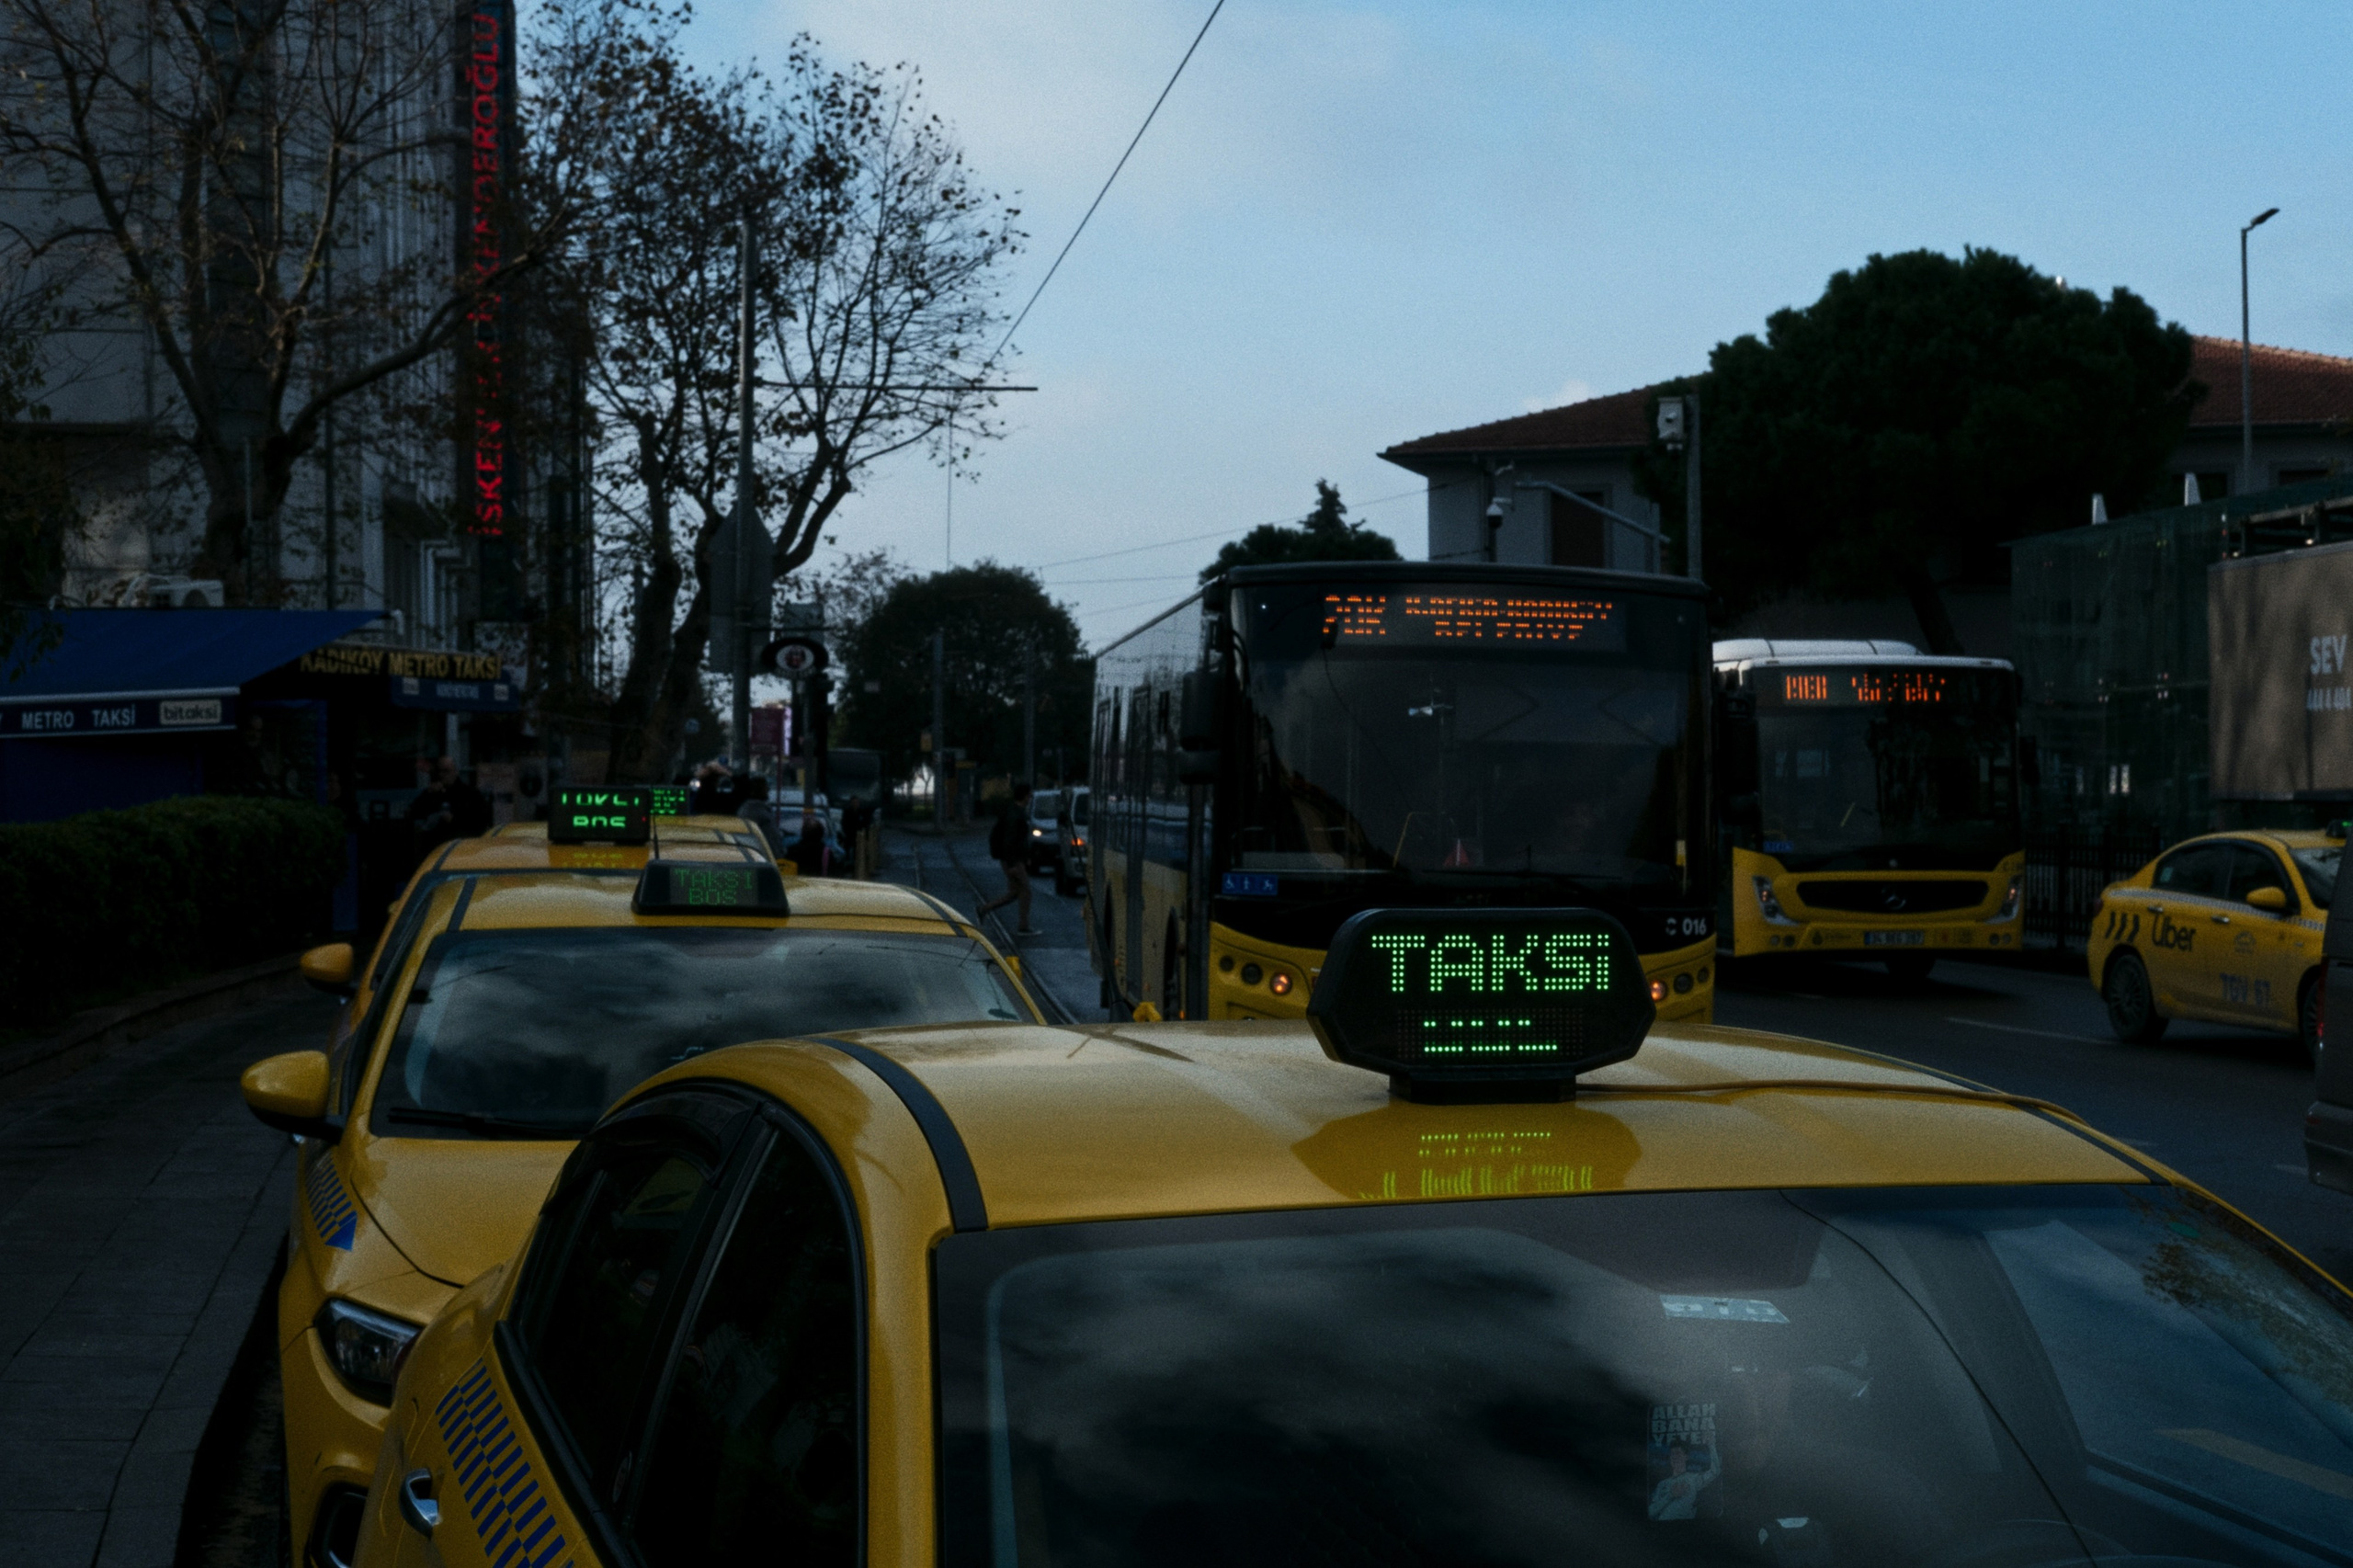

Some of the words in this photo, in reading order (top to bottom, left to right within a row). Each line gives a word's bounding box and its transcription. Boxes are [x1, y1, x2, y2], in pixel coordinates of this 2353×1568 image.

[388, 652, 449, 678] METRO
[453, 653, 503, 680] TAKSİ
[2310, 635, 2347, 674] SEV
[20, 710, 75, 731] METRO
[92, 702, 136, 729] TAKSİ
[164, 704, 219, 721] bitaksi
[1682, 916, 1708, 937] 016
[2152, 912, 2197, 952] Uber
[1652, 1403, 1716, 1420] ALLAH
[1652, 1416, 1716, 1433] BANA
